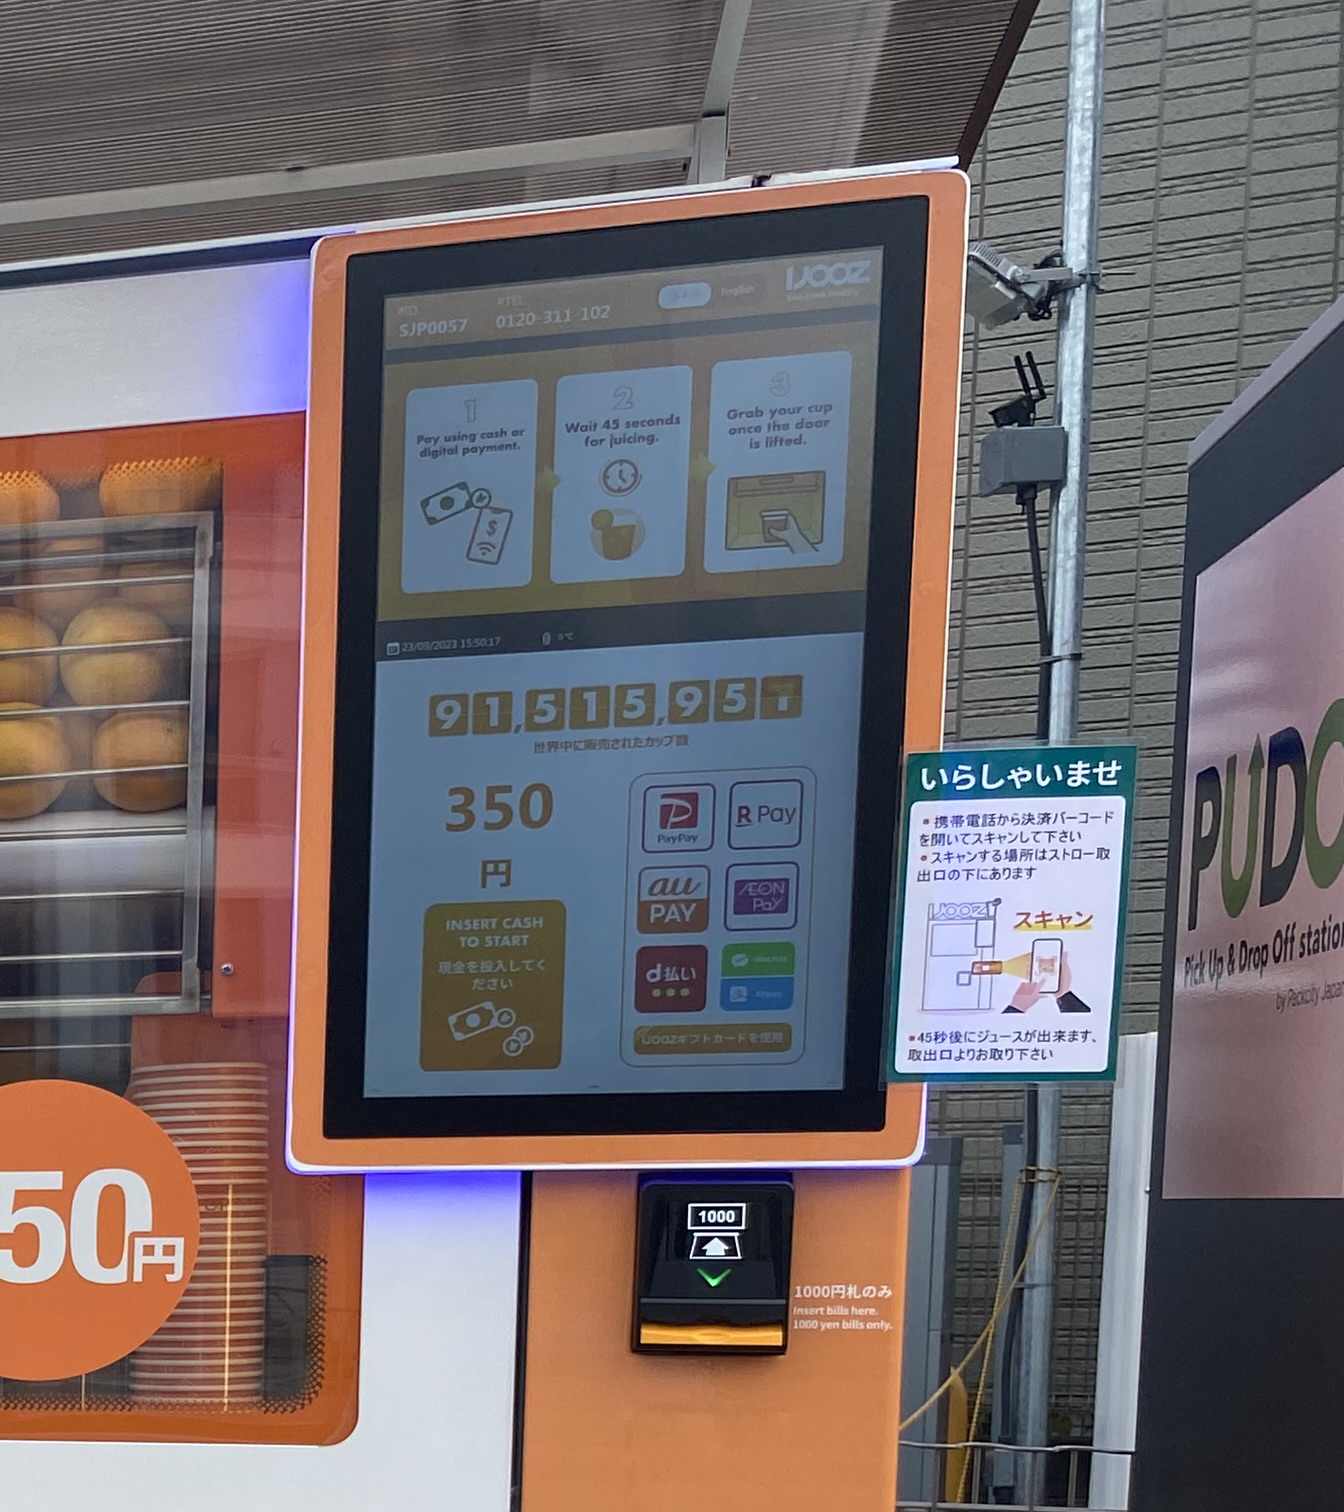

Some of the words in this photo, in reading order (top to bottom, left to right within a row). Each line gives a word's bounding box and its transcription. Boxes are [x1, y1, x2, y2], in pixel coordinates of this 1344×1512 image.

[399, 319, 468, 338] SJP0057
[727, 406, 765, 421] Grab
[769, 404, 803, 420] your
[808, 401, 833, 417] cup
[565, 419, 599, 434] Wait
[602, 418, 620, 431] 45
[624, 414, 681, 429] seconds
[729, 422, 761, 436] once
[766, 418, 794, 433] the
[797, 416, 830, 431] door
[416, 434, 440, 448] Pay
[444, 432, 477, 446] using
[481, 429, 509, 442] cash
[512, 428, 525, 439] or
[584, 434, 605, 448] for
[609, 432, 659, 450] juicing.
[750, 436, 761, 449] is
[765, 434, 807, 449] lifted.
[419, 443, 459, 459] digital
[462, 440, 521, 457] payment.
[533, 734, 689, 755] 世界中に販売されたカップ数
[920, 760, 1122, 791] いらしゃいませ
[444, 782, 554, 833] 350
[757, 804, 797, 826] Pay
[934, 811, 1114, 829] 携帯電話から決済バーコード
[657, 832, 698, 845] PayPay
[919, 831, 1081, 847] を開いてスキャンして下さい
[930, 847, 1110, 864] スキャンする場所はストロー取
[479, 859, 513, 889] 円
[917, 867, 1036, 883] 出口の下にあります
[647, 876, 701, 897] au
[649, 903, 696, 923] PAY
[1014, 910, 1093, 929] スキャン
[446, 918, 497, 931] INSERT
[502, 916, 543, 930] CASH
[459, 935, 480, 948] TO
[484, 934, 529, 948] START
[1208, 948, 1224, 990] Up
[1227, 943, 1235, 976] &
[1238, 939, 1268, 979] Drop
[1272, 921, 1296, 964] Off
[438, 959, 546, 974] 現金を投入してく
[646, 963, 696, 984] d払い
[472, 977, 514, 992] ださい
[917, 1030, 1097, 1045] 45秒後にジュースが出来ます、
[908, 1047, 1053, 1062] 取出口よりお取り下さい
[698, 1210, 735, 1223] 1000
[794, 1285, 892, 1299] 1000円札のみ
[793, 1305, 824, 1316] Insert
[826, 1305, 849, 1316] bills
[851, 1305, 878, 1316] here.
[793, 1319, 818, 1330] 1000
[820, 1321, 840, 1331] yen
[841, 1319, 864, 1330] bills
[866, 1319, 893, 1331] only.
